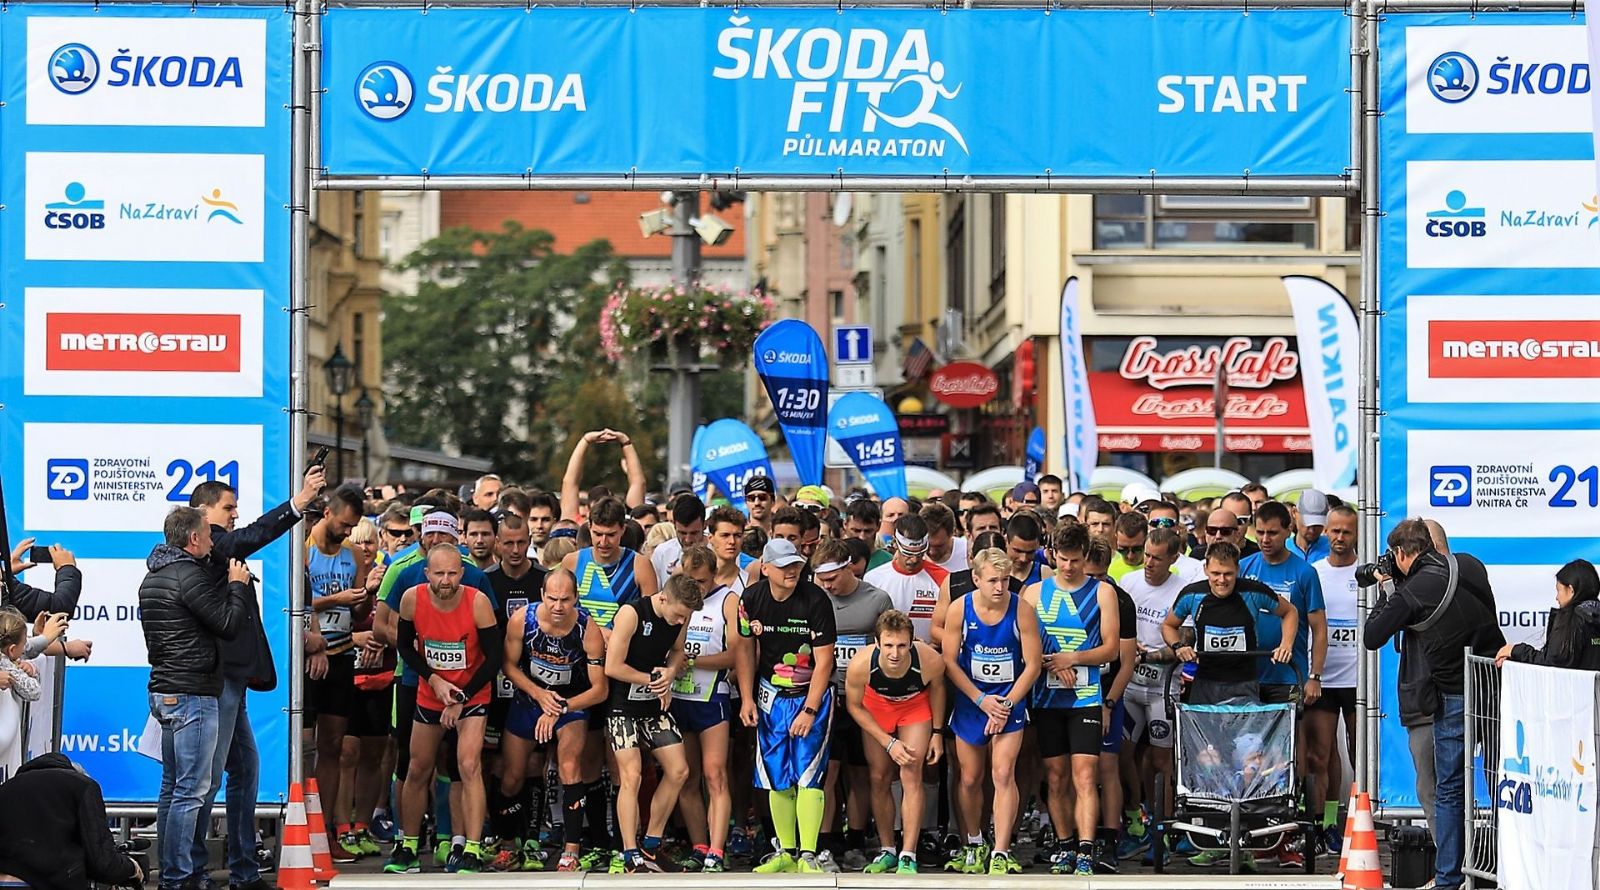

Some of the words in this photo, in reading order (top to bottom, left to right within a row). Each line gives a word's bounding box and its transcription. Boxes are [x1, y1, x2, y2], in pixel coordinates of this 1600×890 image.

[713, 15, 931, 80] ŠKODA
[107, 48, 244, 88] ŠKODA
[1486, 56, 1591, 95] ŠKOD
[424, 65, 587, 113] ŠKODA
[1156, 74, 1308, 114] START
[786, 81, 895, 132] FIT
[782, 133, 946, 157] PŮLMARATON
[44, 210, 105, 229] ČSOB
[119, 203, 199, 220] NaZdraví
[1425, 219, 1487, 238] ČSOB
[1500, 210, 1580, 227] NaZdraví
[778, 351, 812, 364] ŠKODA
[777, 387, 821, 410] 1:30
[856, 437, 895, 460] 1:45
[93, 456, 151, 467] ZDRAVOTNÍ
[1476, 462, 1533, 474] ZDRAVOTNÍ
[94, 468, 156, 479] POJIŠŤOVNA
[166, 459, 239, 502] 211
[1476, 474, 1539, 485] POJIŠŤOVNA
[93, 481, 164, 490] MINISTERSTVA
[1476, 487, 1546, 496] MINISTERSTVA
[1548, 464, 1599, 508] 21
[93, 492, 129, 501] VNITRA
[132, 491, 145, 501] ČR
[1476, 499, 1512, 508] VNITRA
[1515, 497, 1529, 508] ČR
[916, 589, 935, 598] RUN
[72, 605, 110, 621] ODA
[325, 611, 341, 624] 77
[1500, 611, 1550, 628] DIGIT
[1211, 636, 1238, 648] 667
[1332, 629, 1356, 641] 421
[685, 642, 701, 655] 98
[427, 650, 462, 662] A4039
[537, 666, 561, 681] 771
[982, 664, 1001, 675] 62
